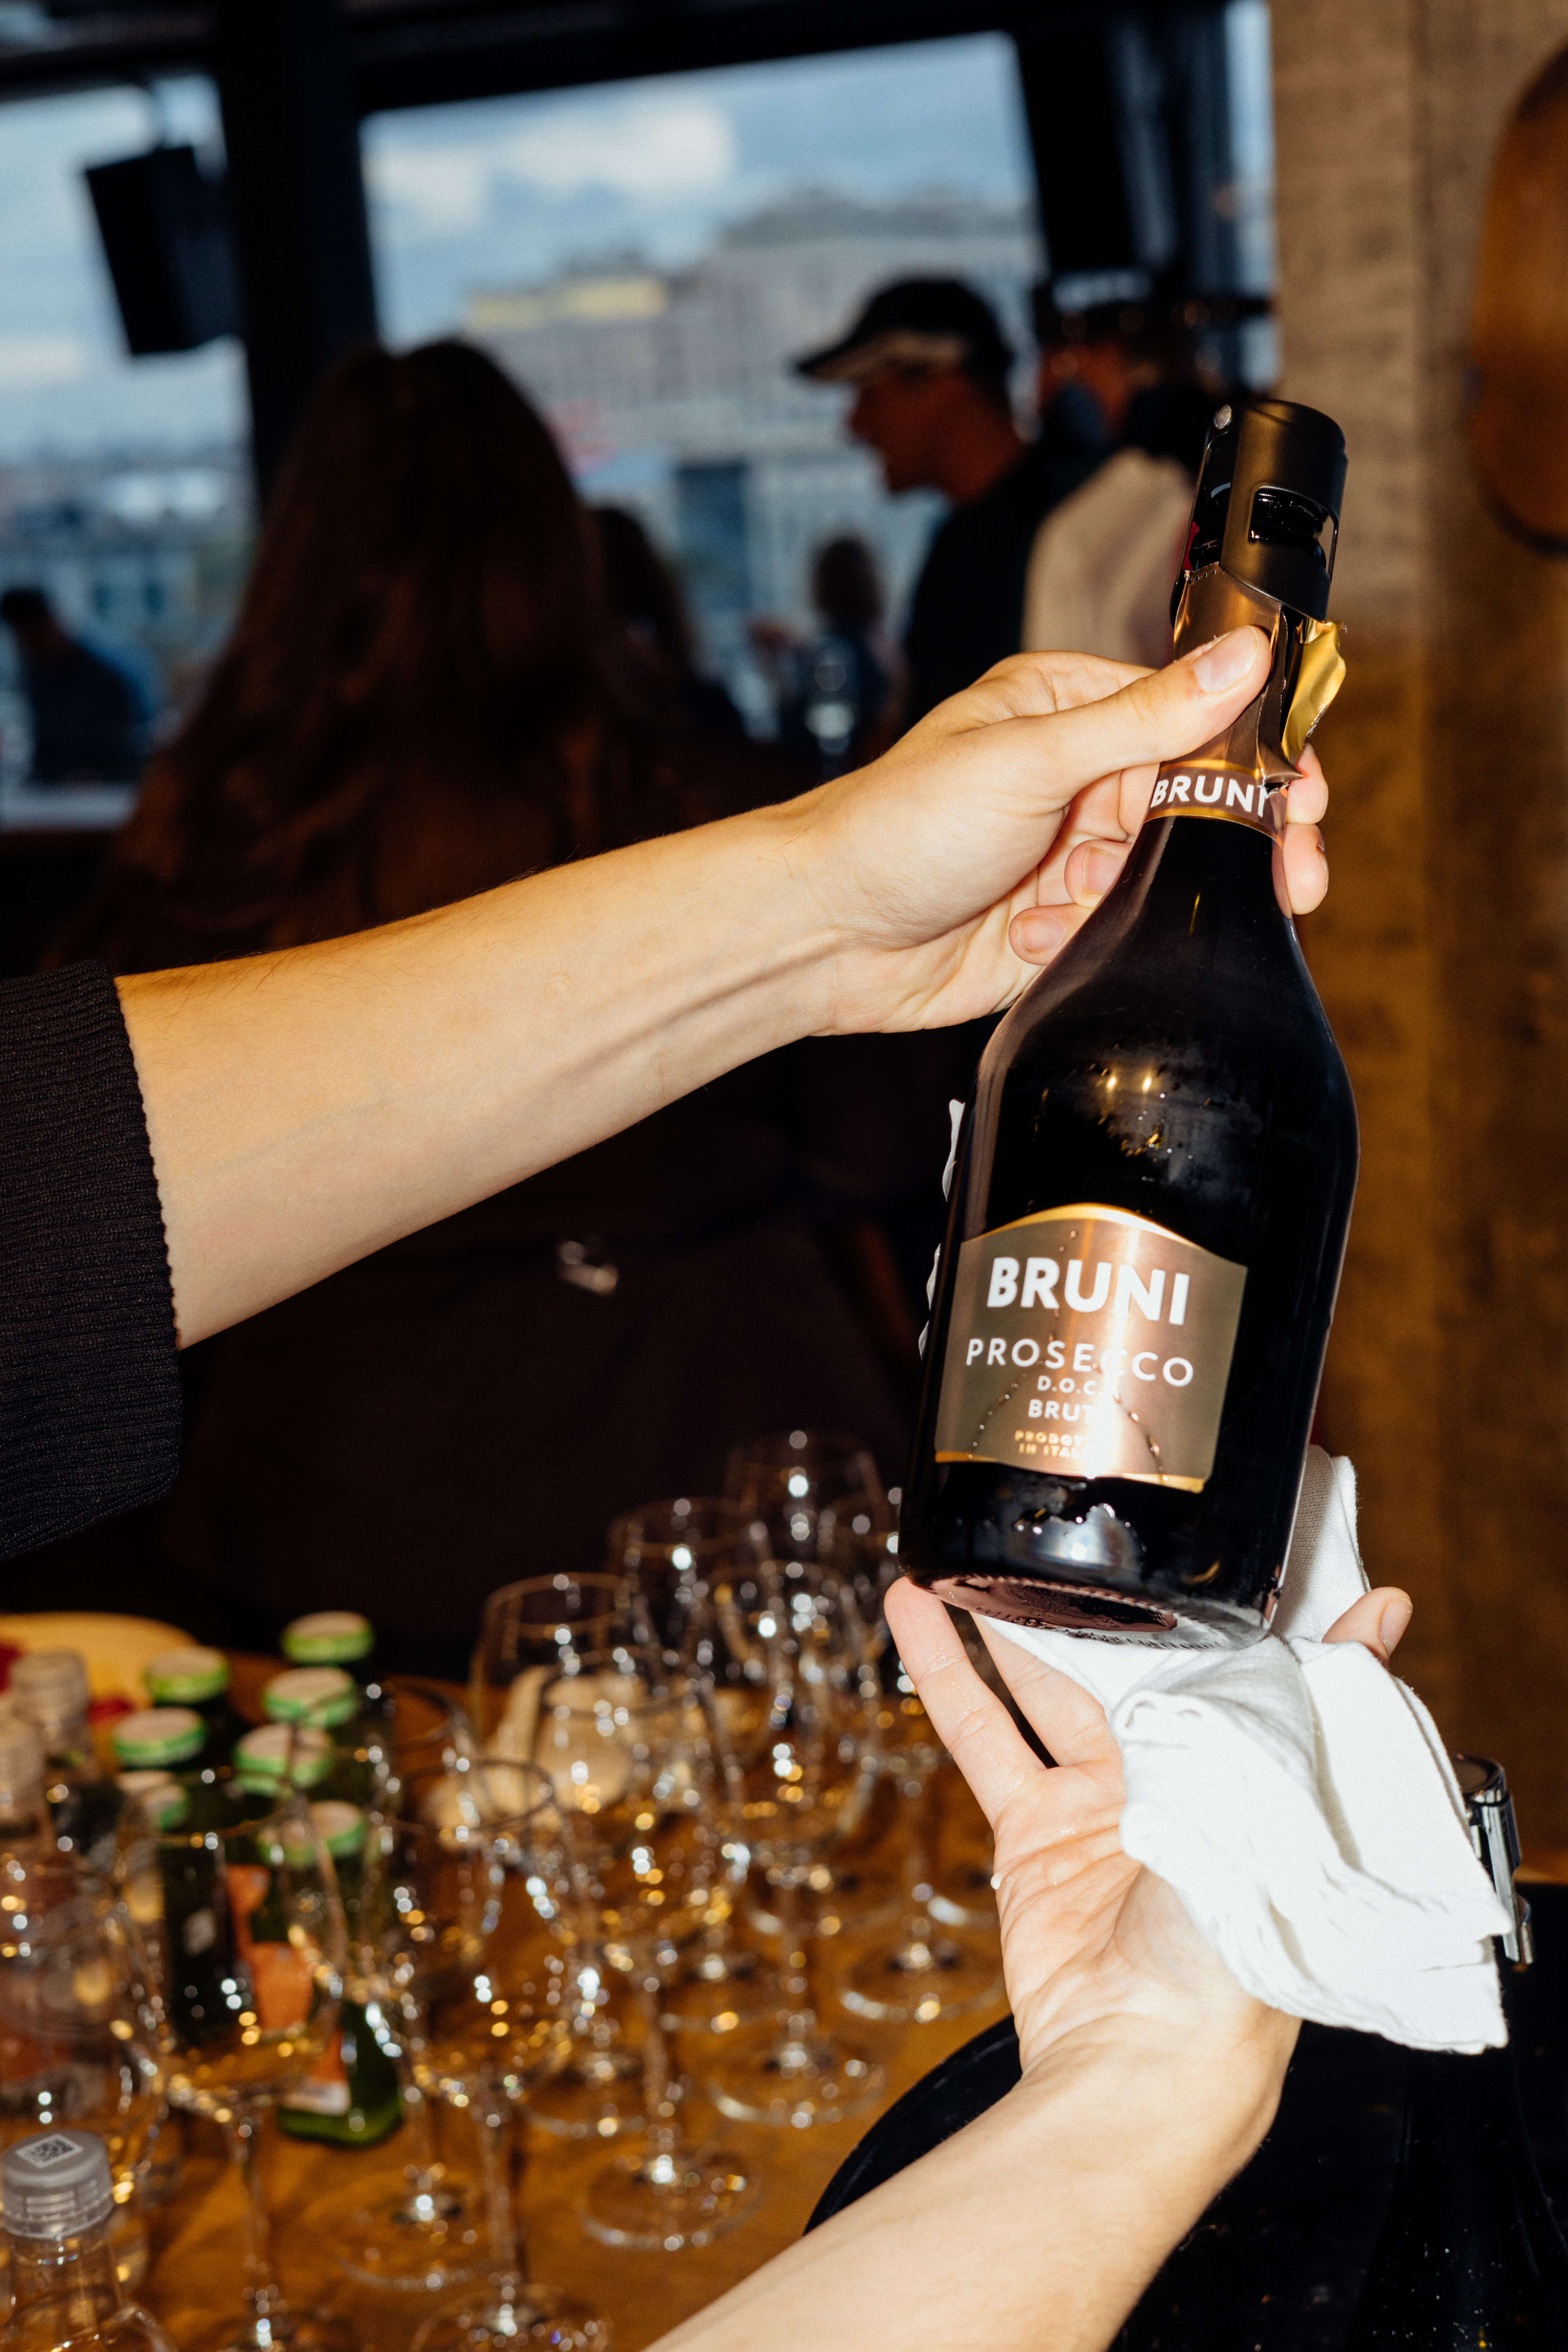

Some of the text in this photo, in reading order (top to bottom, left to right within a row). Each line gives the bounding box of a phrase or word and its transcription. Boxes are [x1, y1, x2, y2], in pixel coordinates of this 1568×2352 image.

[1150, 776, 1267, 818] BRUNI
[987, 1257, 1190, 1325] BRUNI
[966, 1338, 1193, 1387] PROSECCO
[1028, 1399, 1099, 1423] BRUT
[1014, 1430, 1094, 1448] PRODOT
[1019, 1443, 1037, 1455] IN
